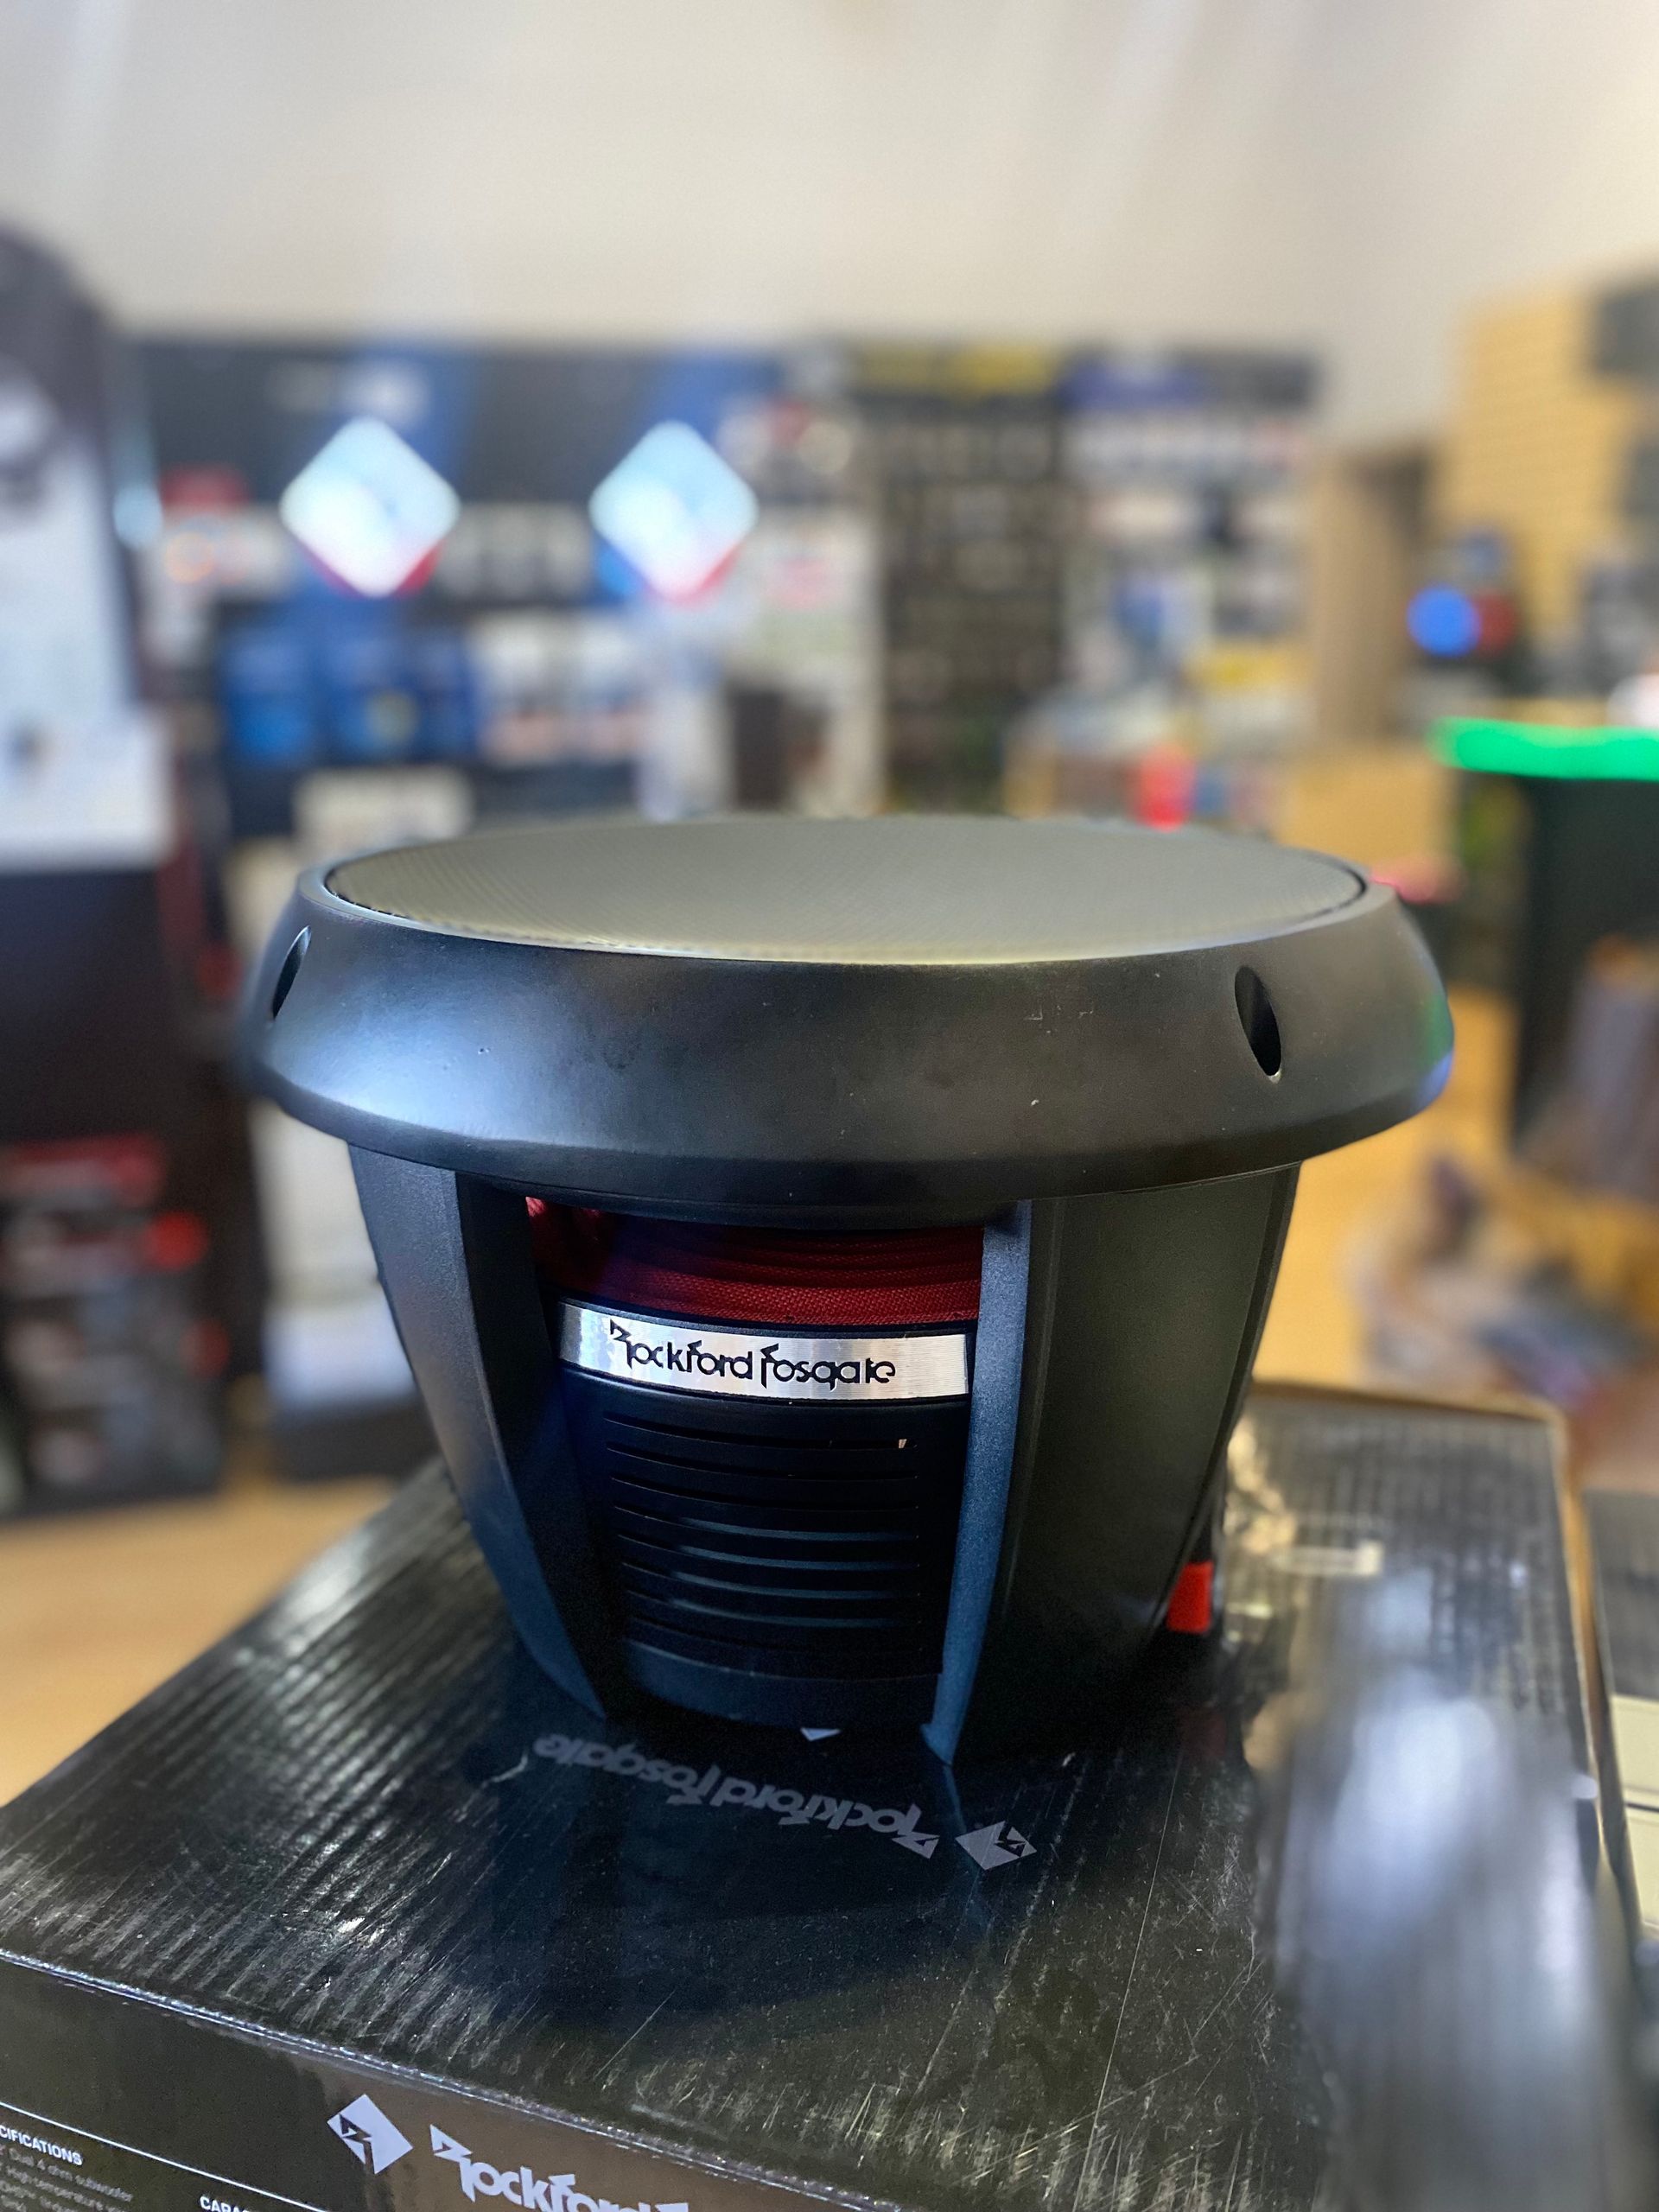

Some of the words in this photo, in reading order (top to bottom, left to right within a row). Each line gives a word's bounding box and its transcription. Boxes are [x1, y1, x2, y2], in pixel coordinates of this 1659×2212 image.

[610, 1319, 754, 1380] Rockford
[760, 1343, 896, 1392] Fosgate
[708, 1778, 939, 1859] Rockford
[430, 2124, 651, 2212] Rockfo
